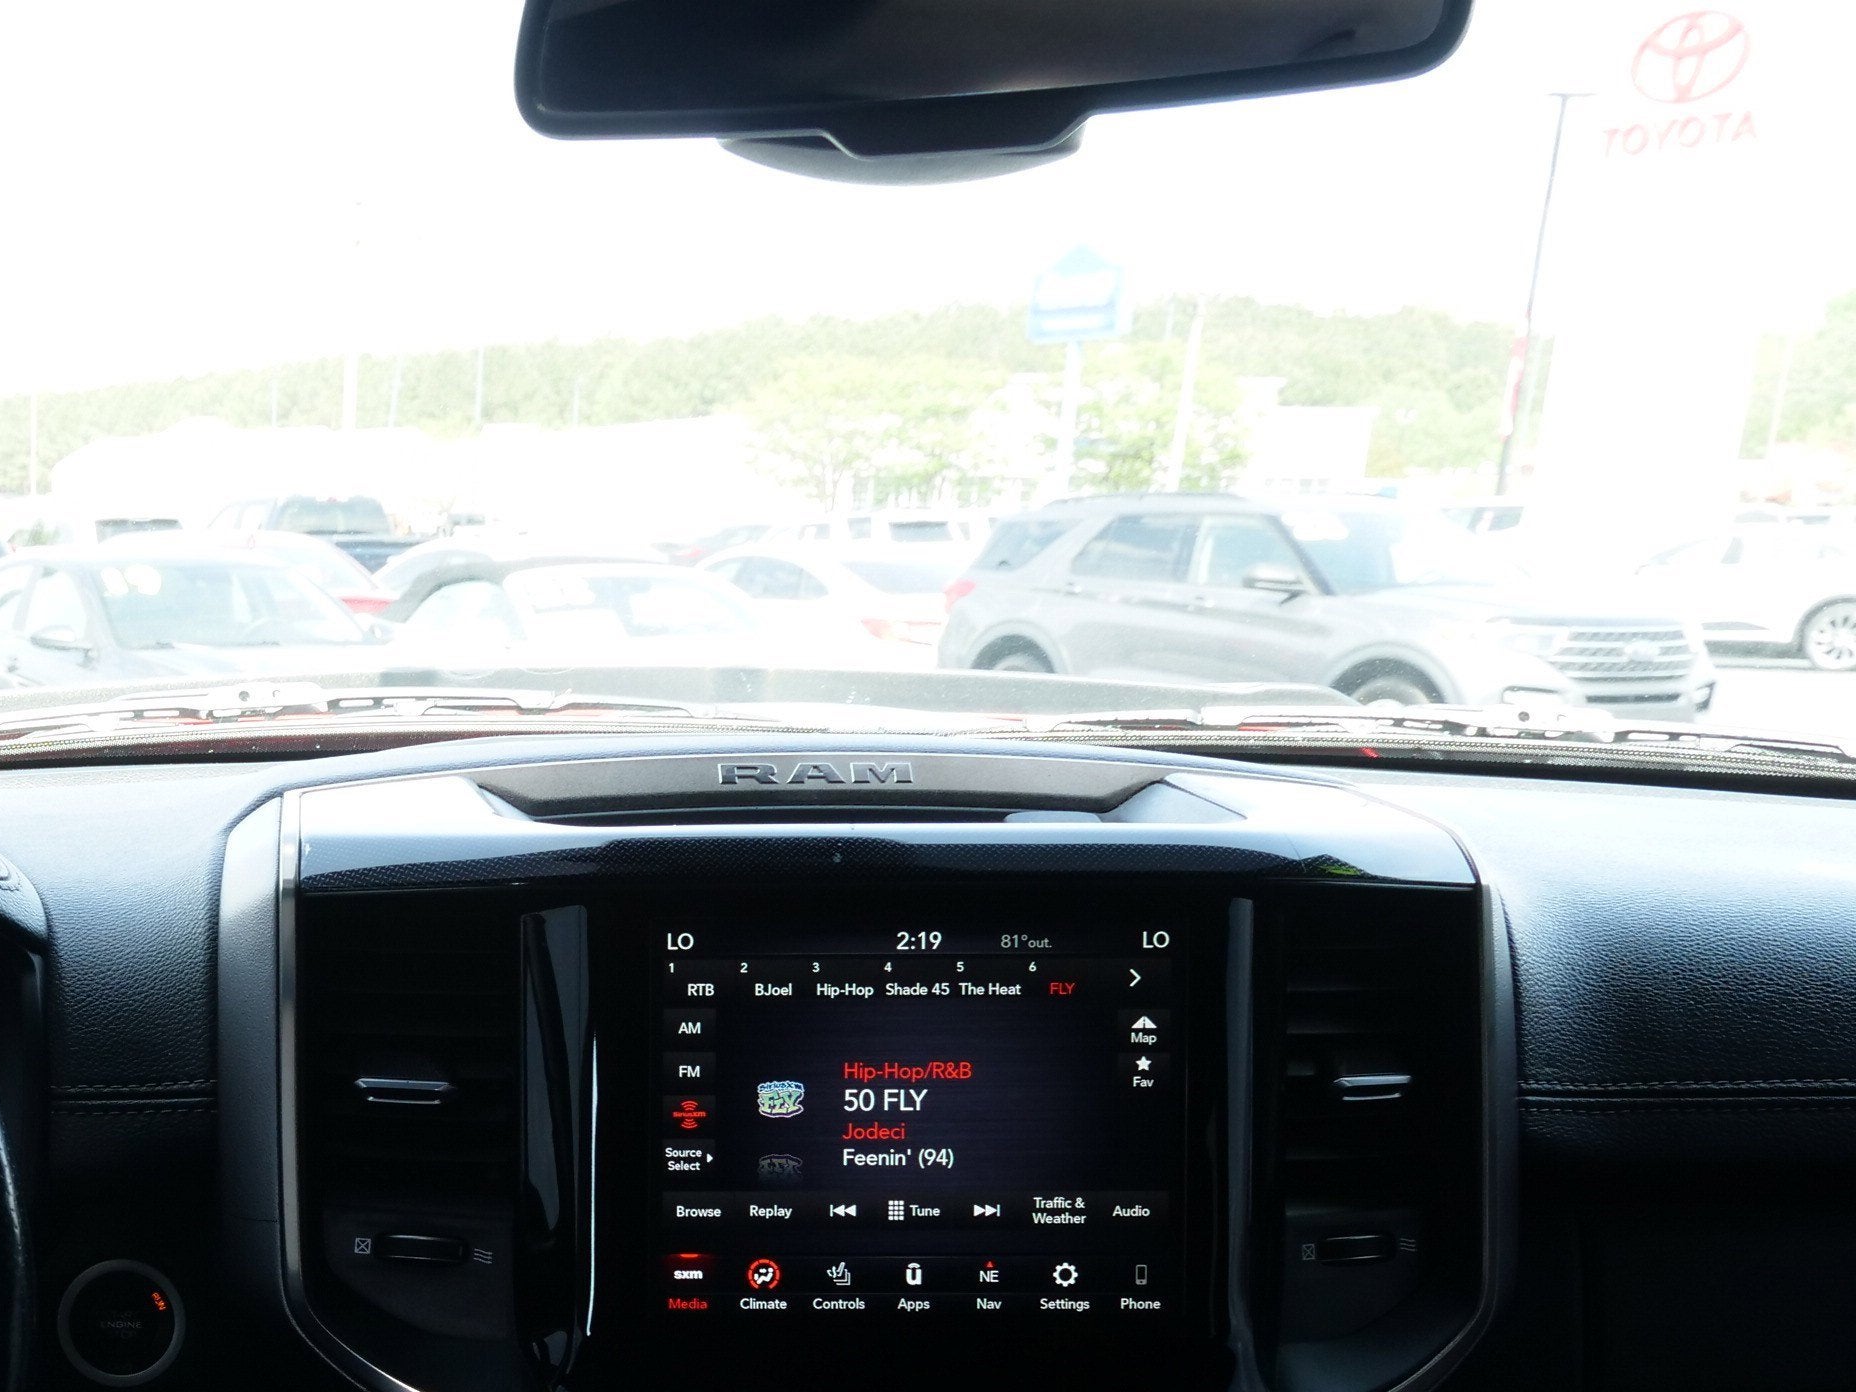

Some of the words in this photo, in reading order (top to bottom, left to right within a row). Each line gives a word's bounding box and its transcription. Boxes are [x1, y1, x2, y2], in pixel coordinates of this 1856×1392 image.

[1603, 111, 1757, 158] TOYOTA
[717, 762, 914, 785] RAM
[667, 932, 695, 951] LO
[896, 931, 943, 951] 2:19
[1142, 930, 1170, 949] LO
[668, 962, 675, 974] 1
[739, 962, 748, 974] 2
[812, 961, 821, 973] 3
[883, 961, 893, 973] 4
[956, 961, 965, 973] 5
[1028, 961, 1037, 972] 6
[687, 982, 715, 997] RTB
[754, 982, 793, 997] BJoel
[816, 982, 875, 999] Hip-Hop
[885, 982, 927, 996] Shade
[931, 982, 951, 996] 45
[958, 982, 984, 996] The
[987, 982, 1022, 996] Heat
[1049, 981, 1076, 996] FLY
[677, 1021, 702, 1035] AM
[1130, 1031, 1158, 1046] Map
[678, 1065, 701, 1078] FM
[843, 1061, 972, 1083] Hip-Hop/R&B
[1132, 1075, 1155, 1088] Fav
[843, 1088, 876, 1112] 50
[883, 1088, 929, 1112] FLY
[842, 1122, 906, 1140] Jodeci
[664, 1147, 703, 1158] Source
[842, 1148, 912, 1167] Feenin'
[918, 1148, 955, 1170] (94)
[667, 1160, 701, 1171] Select
[1032, 1196, 1072, 1209] Traffic
[1074, 1196, 1086, 1209] &
[676, 1205, 722, 1218] Browse
[749, 1204, 793, 1220] Replay
[908, 1204, 941, 1217] Tune
[1112, 1204, 1151, 1217] Audio
[1031, 1211, 1087, 1225] Weather
[673, 1269, 704, 1280] sxm
[979, 1269, 1000, 1283] NE
[667, 1297, 709, 1310] Media
[739, 1297, 788, 1310] Climate
[812, 1297, 866, 1310] Controls
[897, 1297, 931, 1312] Apps
[976, 1297, 1003, 1310] Nav
[1039, 1297, 1091, 1313] Settings
[1120, 1297, 1162, 1310] Phone
